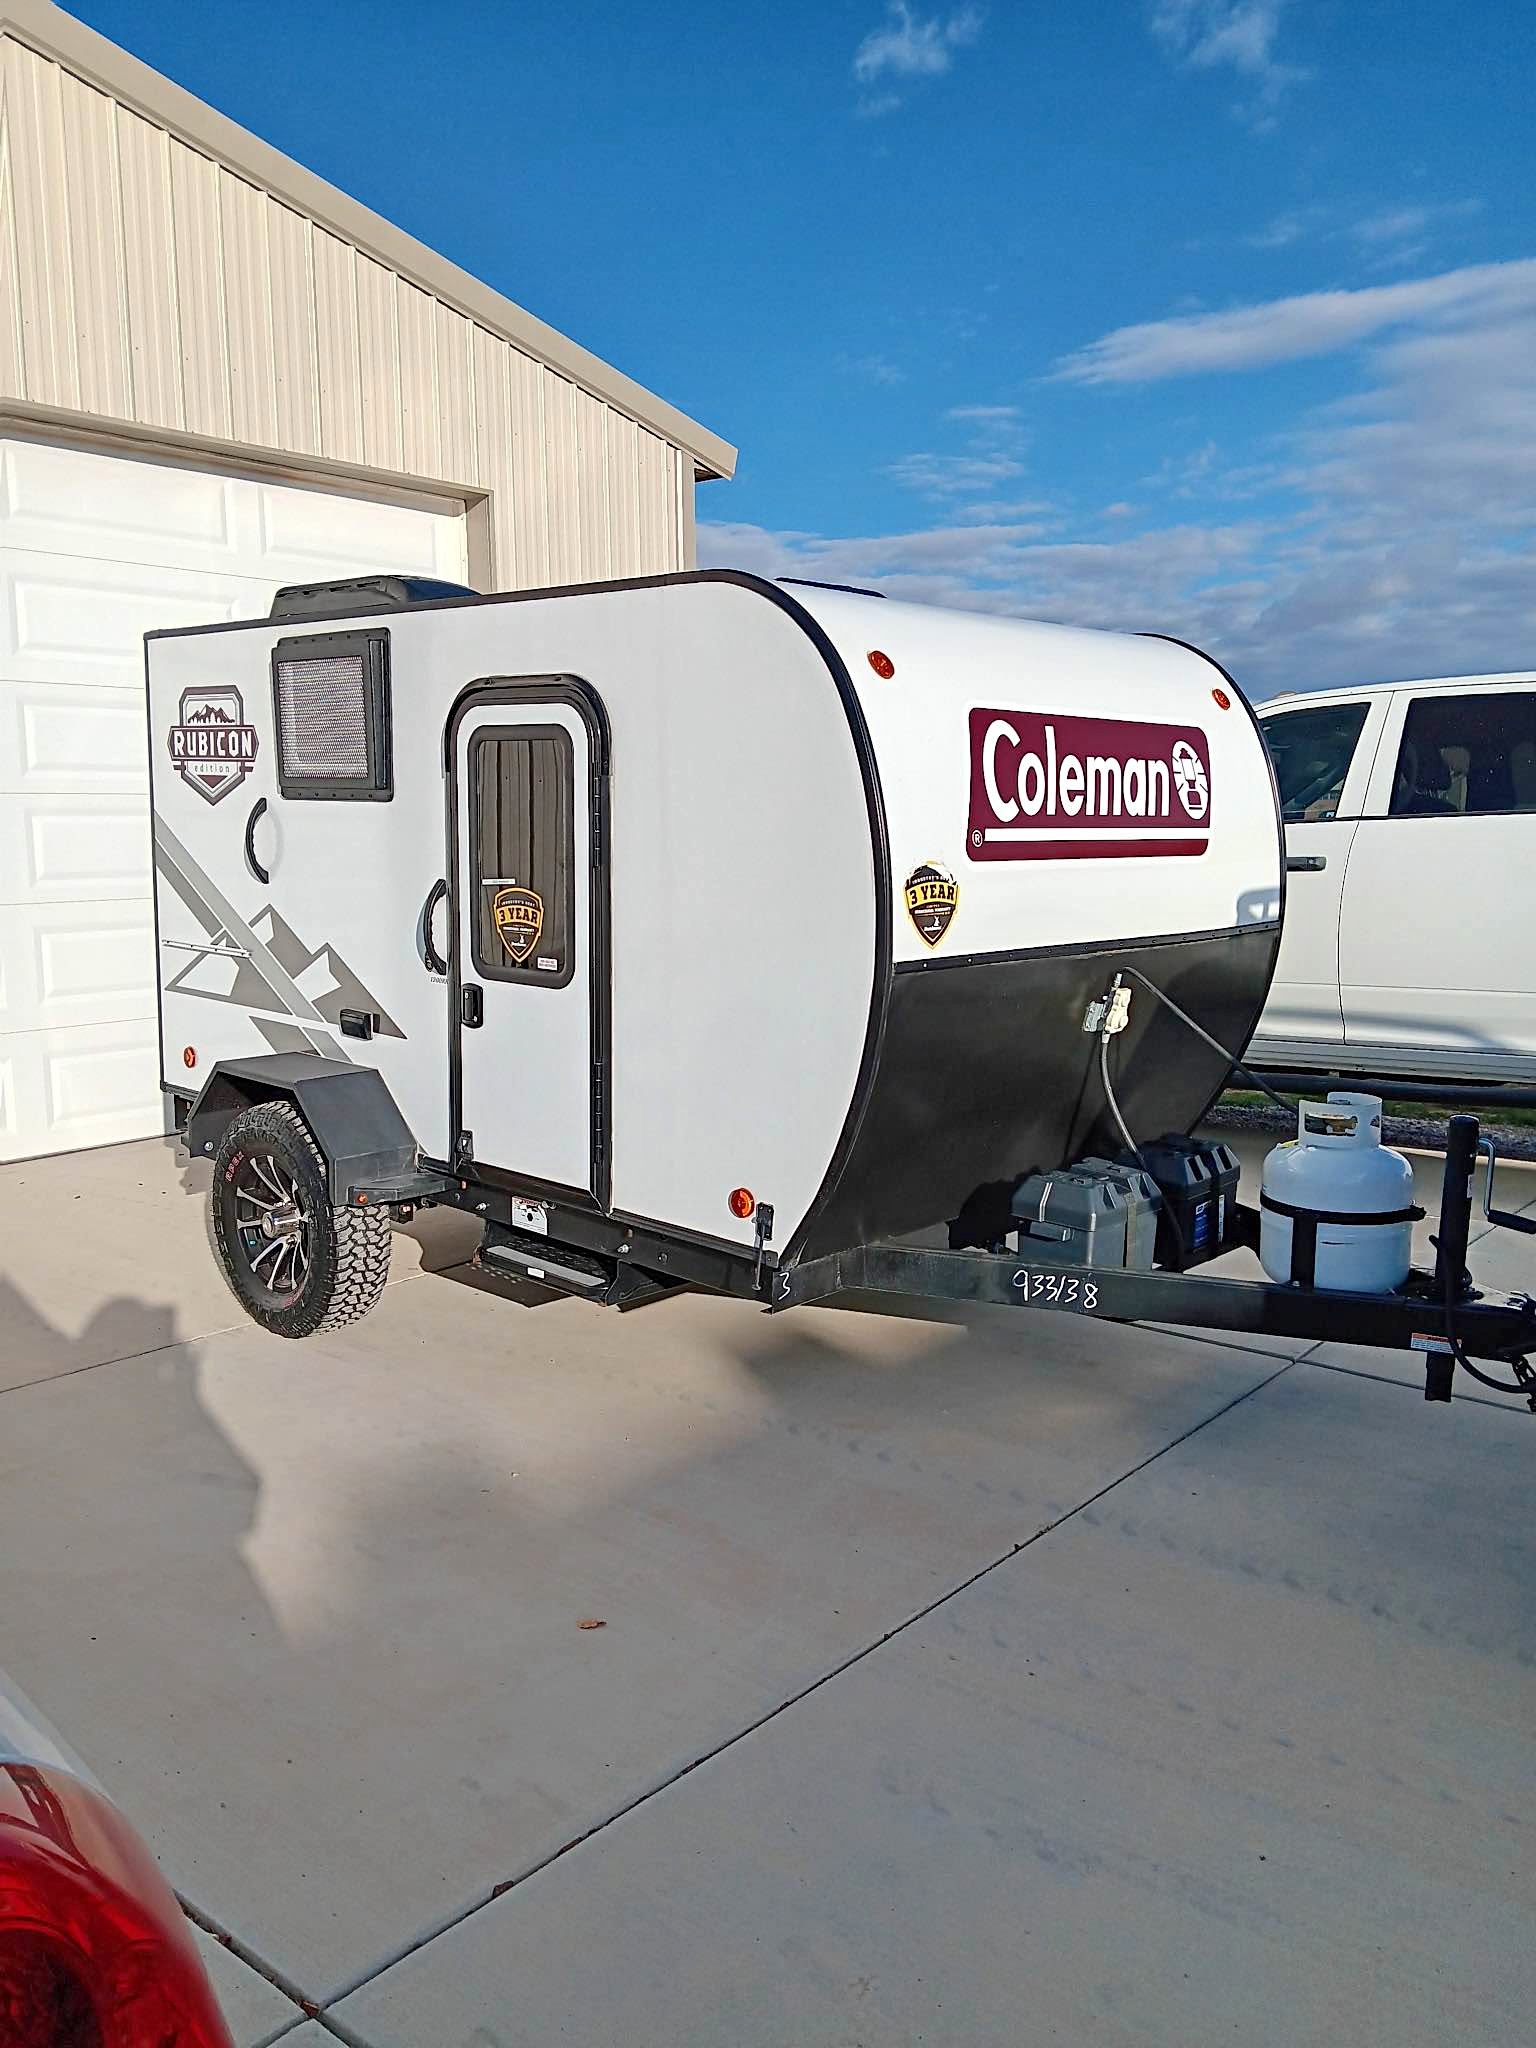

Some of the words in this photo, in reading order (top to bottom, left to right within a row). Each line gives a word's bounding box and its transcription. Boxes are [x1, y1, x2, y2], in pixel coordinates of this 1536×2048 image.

[173, 730, 253, 757] RUBICON
[194, 764, 230, 773] edition
[982, 719, 1170, 823] Coleman
[909, 889, 918, 905] 3
[920, 884, 955, 902] YEAR
[499, 909, 506, 922] 3
[508, 907, 538, 924] YEAR
